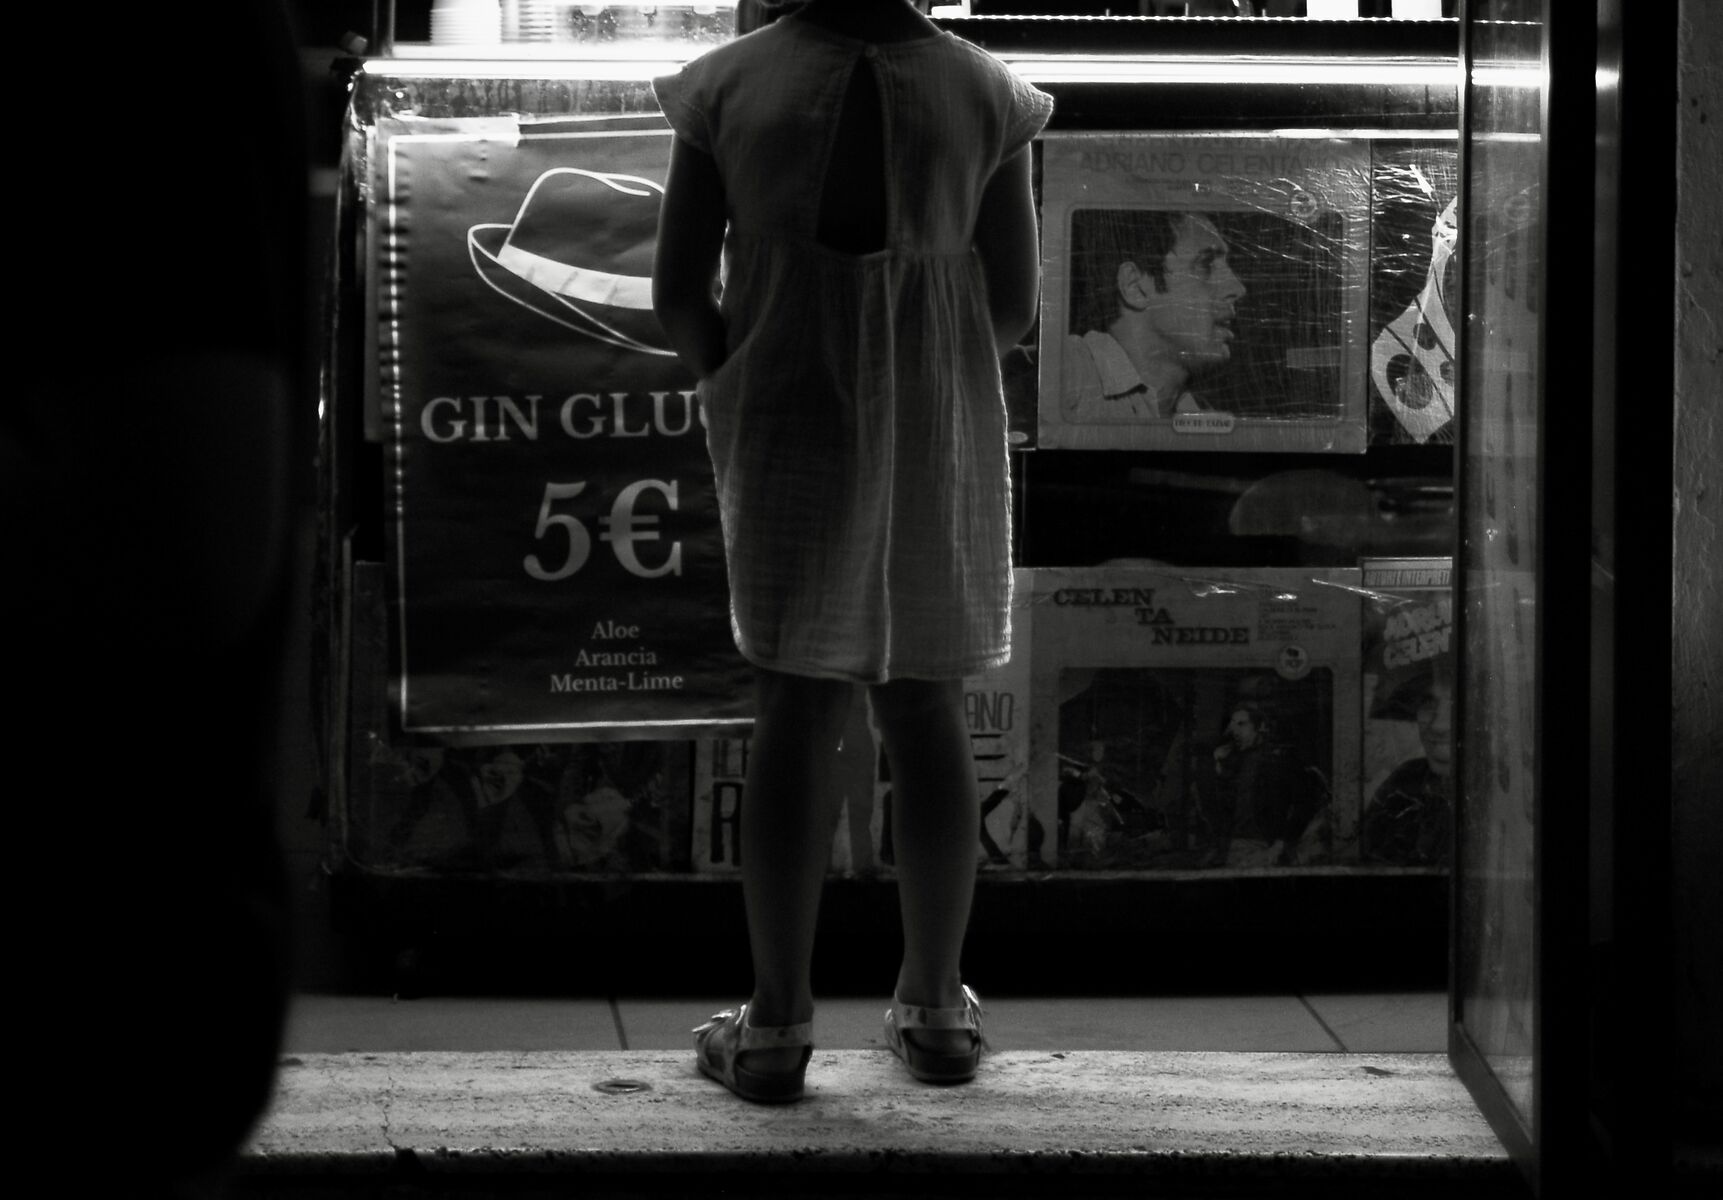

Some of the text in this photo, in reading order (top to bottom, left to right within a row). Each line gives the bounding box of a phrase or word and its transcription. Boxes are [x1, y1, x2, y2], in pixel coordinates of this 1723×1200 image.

[420, 390, 707, 443] GIN GLU
[523, 479, 682, 581] 5€
[1053, 588, 1155, 606] CELEN
[1135, 607, 1174, 625] TA
[590, 620, 640, 640] Aloe
[1151, 627, 1249, 645] NEIDE
[574, 648, 658, 668] Arancia
[549, 671, 683, 694] Menta-Lime
